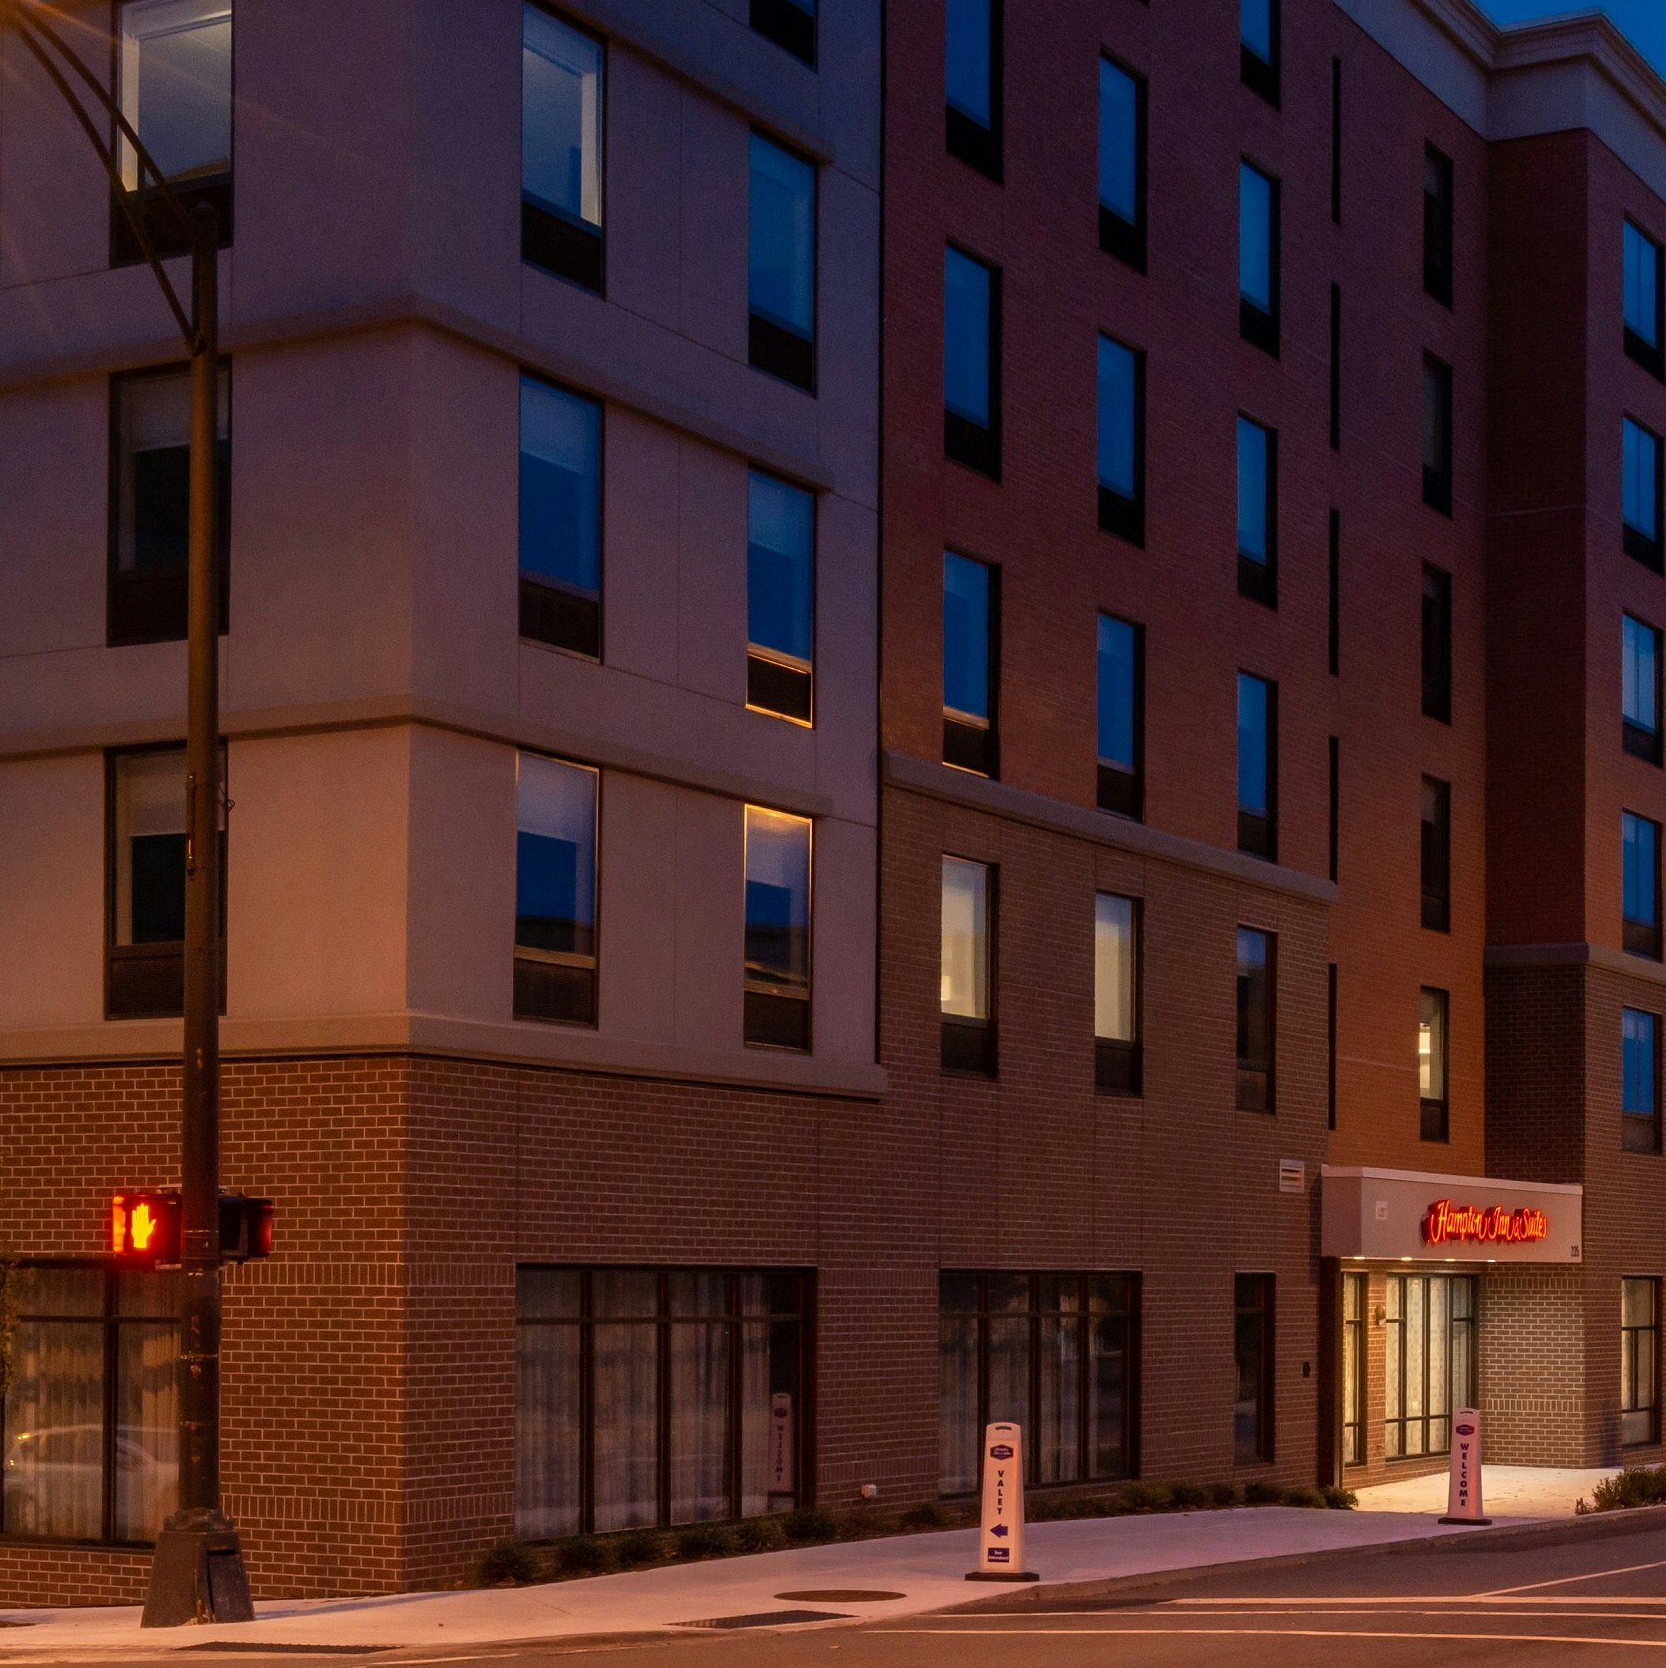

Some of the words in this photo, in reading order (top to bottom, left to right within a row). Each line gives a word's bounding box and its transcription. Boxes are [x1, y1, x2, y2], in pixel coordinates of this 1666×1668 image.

[1431, 1199, 1488, 1243] Hampton
[1487, 1206, 1515, 1240] Inn
[1519, 1208, 1547, 1238] Suites
[1459, 1443, 1470, 1507] WELCOME
